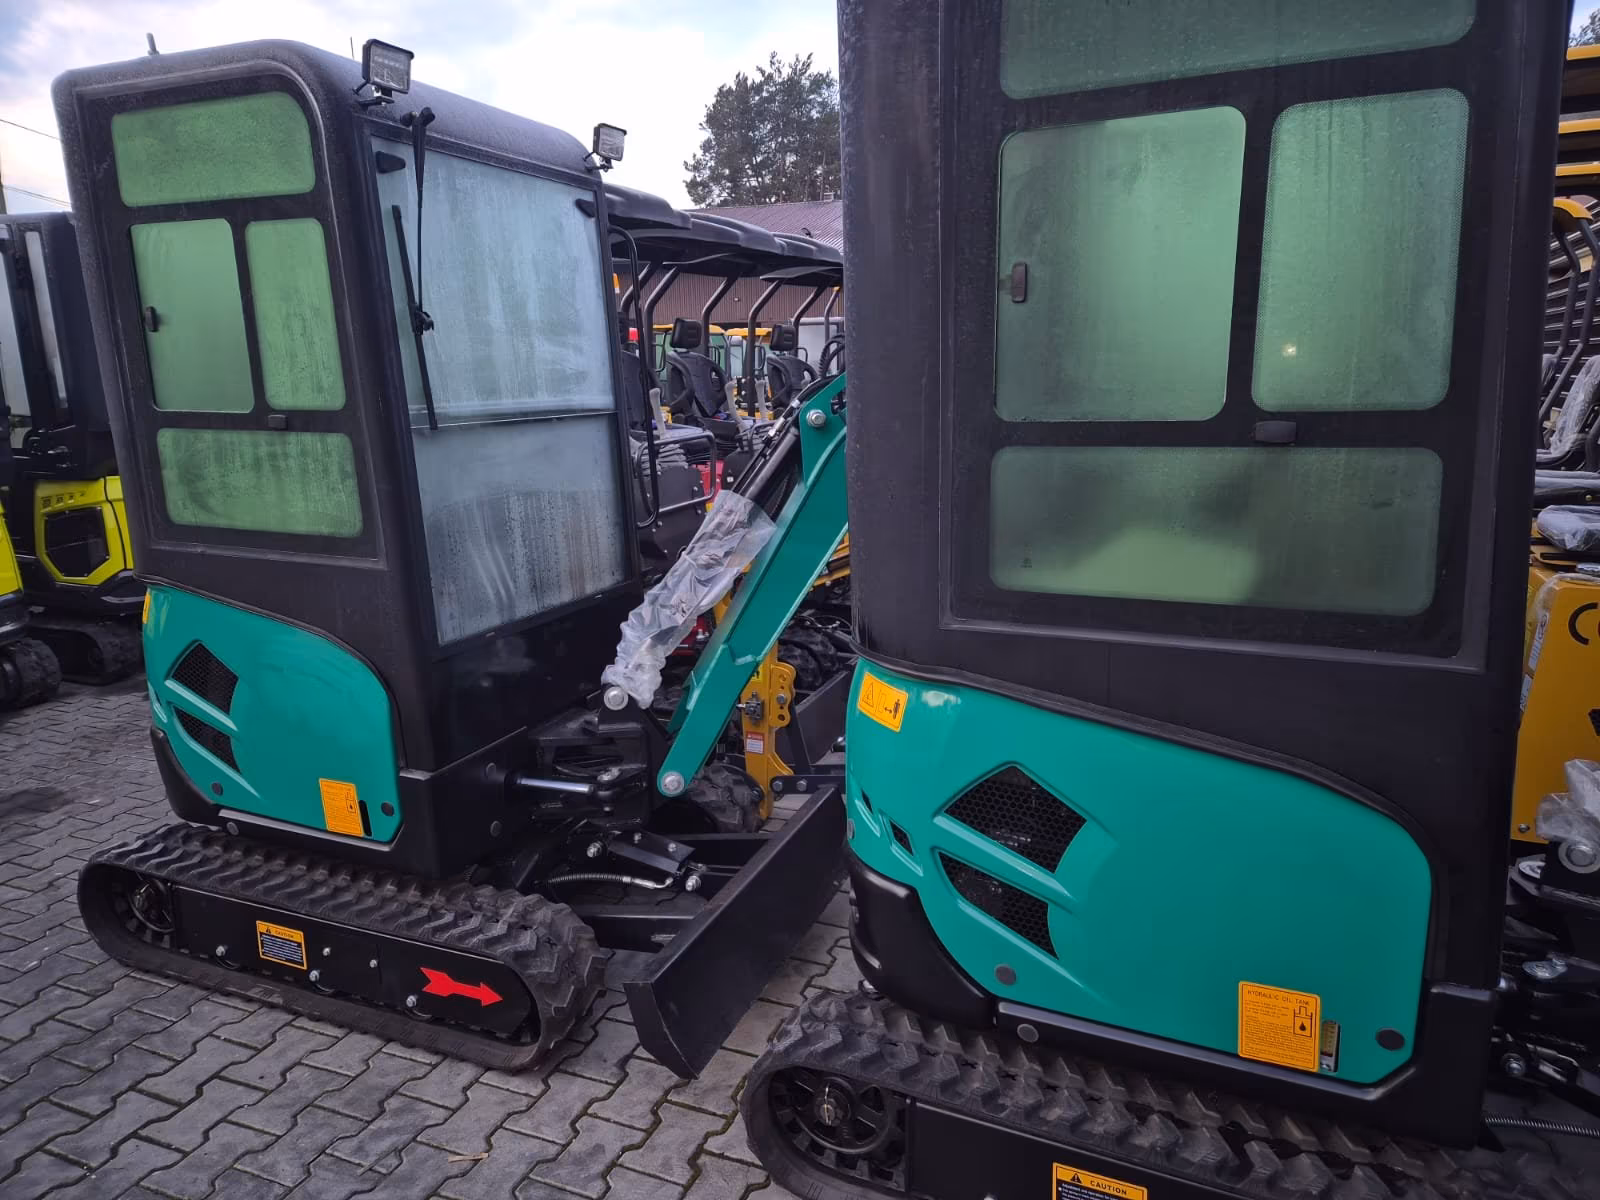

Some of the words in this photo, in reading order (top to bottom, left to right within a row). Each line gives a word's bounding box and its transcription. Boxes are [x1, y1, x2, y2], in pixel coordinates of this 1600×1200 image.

[1248, 990, 1279, 1001] HYDRAULIC
[1295, 998, 1310, 1006] TANK
[1090, 1180, 1127, 1195] CAUTION
